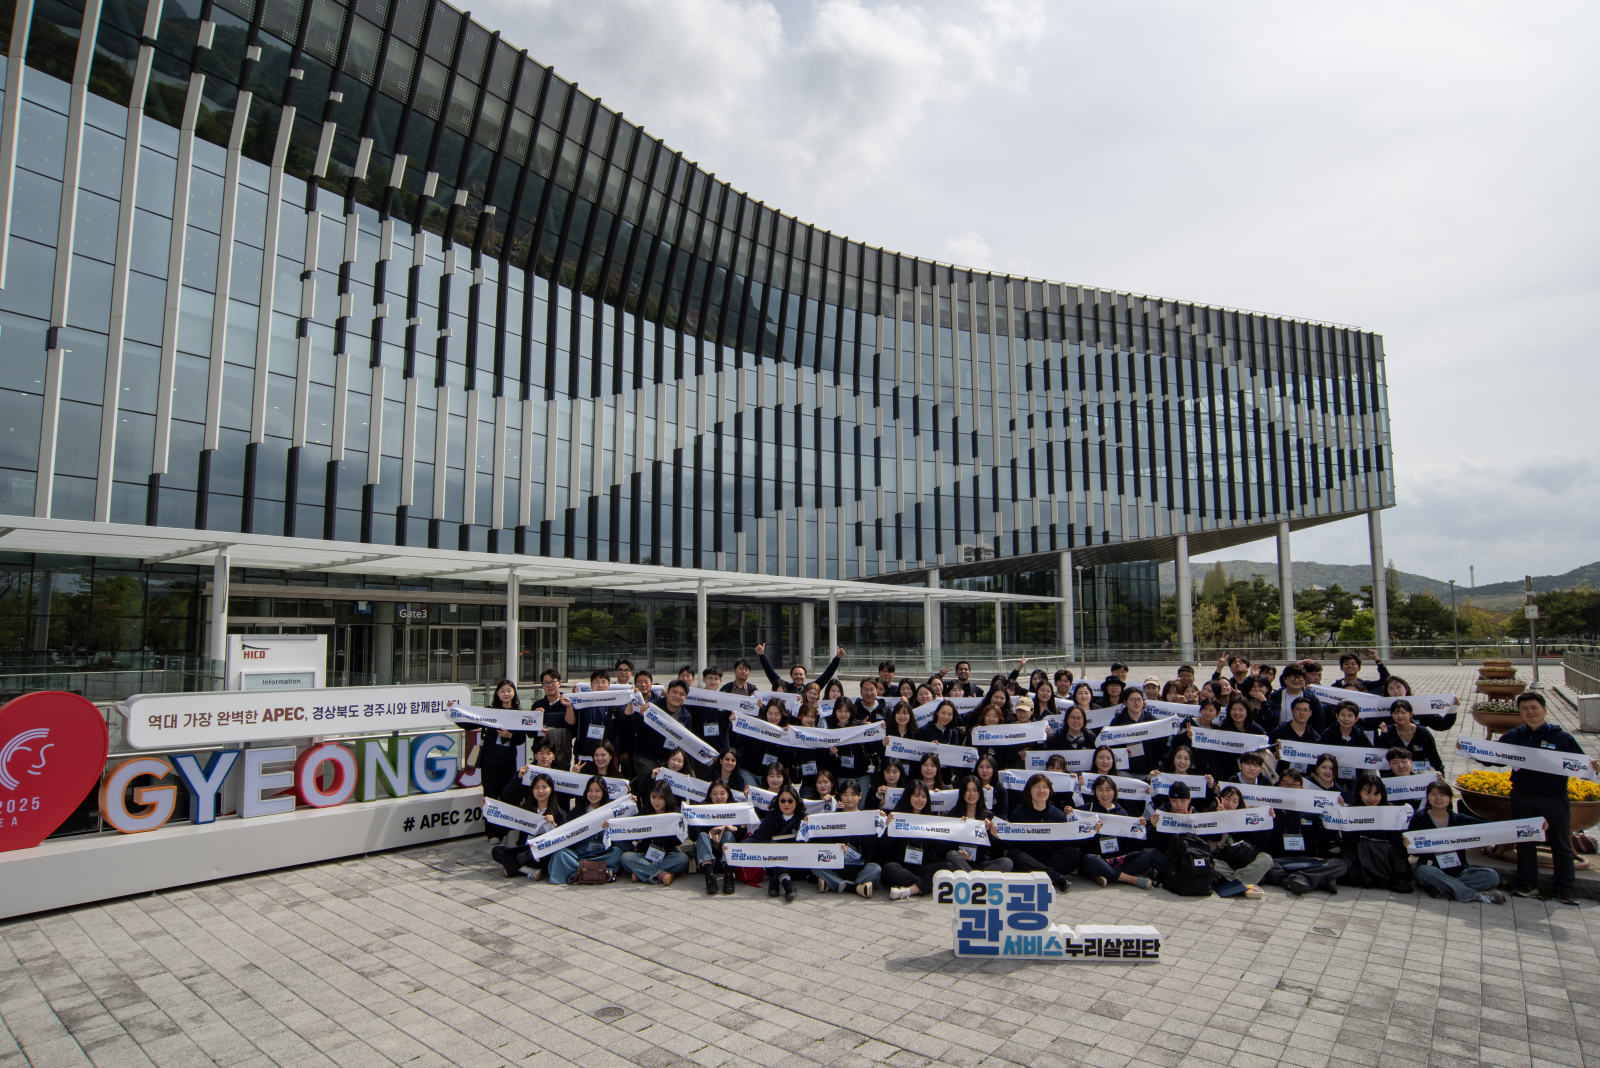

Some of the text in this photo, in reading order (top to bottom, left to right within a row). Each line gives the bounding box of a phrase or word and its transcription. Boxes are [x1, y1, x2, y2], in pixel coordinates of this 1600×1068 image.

[400, 609, 427, 618] Gate3
[243, 650, 266, 659] HICO
[148, 699, 460, 730] 역대 가장 완벽한 APEC, 경상북도 경주시와 함께합
[1282, 749, 1312, 758] 관광서비스
[1562, 761, 1588, 772] Korea
[1003, 776, 1026, 784] 관광서비
[1386, 786, 1410, 794] 광서비스
[420, 810, 460, 830] APEC
[464, 806, 484, 822] 20
[1246, 816, 1265, 826] Korea
[1162, 820, 1192, 828] 관광서비스
[1516, 829, 1540, 838] Korea
[1414, 840, 1450, 848] 관광서비스
[731, 852, 762, 861] 관광서비스
[818, 854, 837, 862] Korea
[938, 882, 1004, 906] 2025
[1003, 935, 1064, 956] 서비스
[1065, 938, 1160, 958] 누리살핌단
